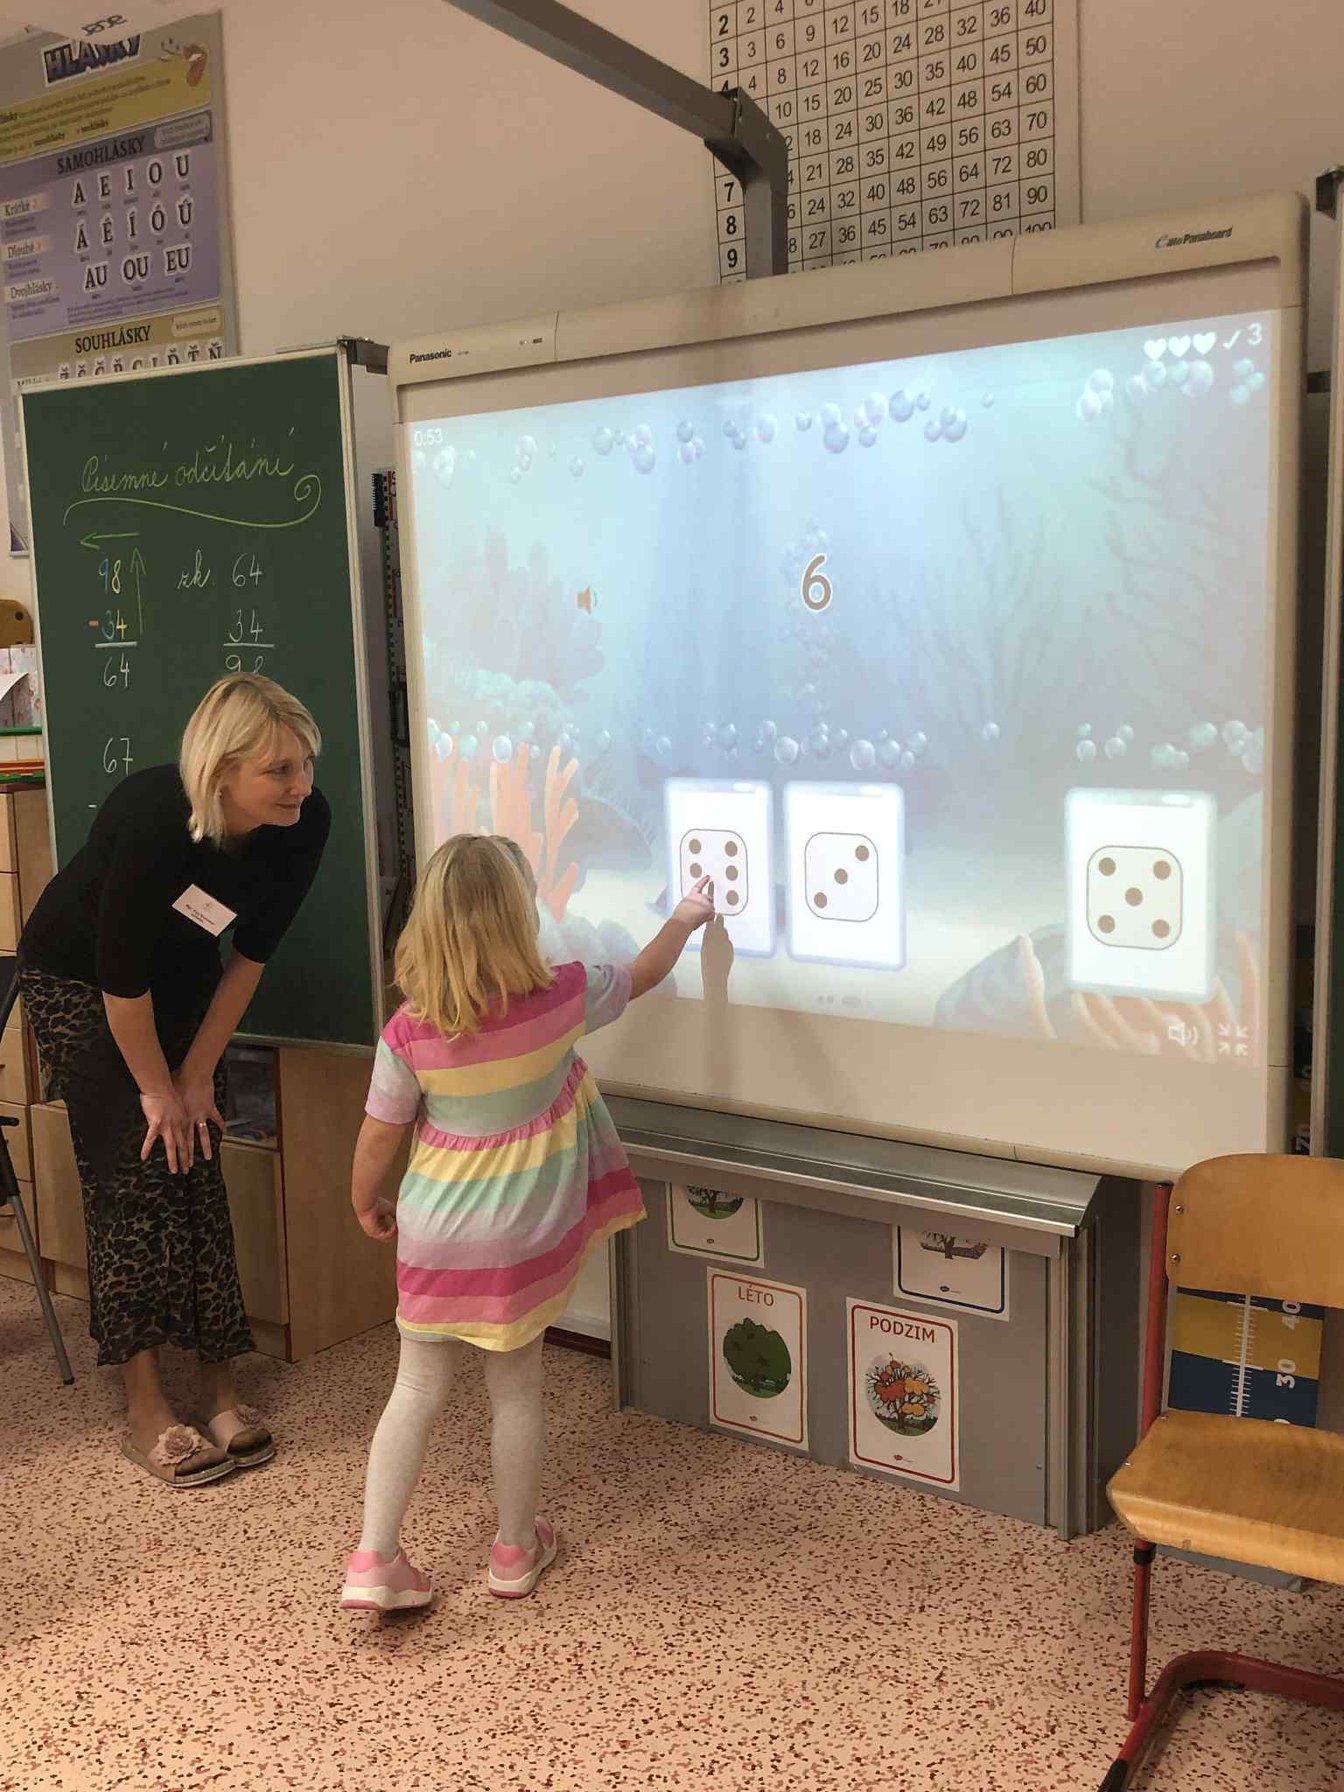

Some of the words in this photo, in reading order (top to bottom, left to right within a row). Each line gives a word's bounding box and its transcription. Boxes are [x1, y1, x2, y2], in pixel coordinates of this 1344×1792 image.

[719, 14, 728, 36] 2
[747, 7, 755, 24] 2
[775, 0, 784, 14] 4
[720, 48, 729, 67] 3
[748, 42, 756, 57] 3
[776, 34, 785, 49] 6
[806, 25, 815, 41] 9
[833, 16, 848, 34] 12
[862, 6, 879, 25] 15
[892, 0, 909, 16] 18
[749, 76, 756, 90] 4
[778, 68, 786, 84] 8
[803, 60, 819, 76] 12
[833, 51, 849, 69] 16
[864, 42, 881, 62] 20
[893, 34, 911, 54] 24
[925, 24, 944, 45] 28
[957, 16, 976, 36] 32
[991, 6, 1010, 27] 36
[1025, 0, 1046, 16] 40
[776, 102, 791, 119] 10
[804, 94, 820, 112] 15
[834, 86, 852, 105] 20
[865, 77, 882, 97] 25
[894, 70, 912, 89] 30
[926, 61, 944, 81] 35
[956, 54, 976, 72] 40
[990, 44, 1010, 63] 45
[1026, 36, 1046, 56] 50
[785, 136, 793, 151] 2
[805, 129, 821, 146] 18
[836, 121, 852, 140] 24
[866, 113, 883, 132] 30
[896, 106, 913, 125] 36
[926, 98, 945, 116] 42
[958, 91, 977, 109] 48
[992, 82, 1012, 102] 54
[1026, 74, 1046, 94] 60
[57, 136, 145, 175] SAMOHLÁSKY
[724, 182, 734, 202] 7
[807, 164, 822, 181] 21
[836, 156, 854, 175] 28
[867, 148, 884, 167] 35
[896, 142, 914, 159] 42
[927, 134, 946, 152] 49
[959, 127, 978, 146] 56
[992, 119, 1011, 138] 63
[1027, 112, 1047, 131] 70
[74, 182, 86, 203] A
[100, 175, 111, 197] E
[127, 169, 134, 190] I
[149, 162, 161, 184] O
[176, 155, 189, 177] U
[726, 216, 736, 234] 8
[808, 197, 825, 215] 24
[838, 191, 854, 209] 32
[867, 184, 885, 201] 40
[896, 177, 915, 194] 48
[928, 170, 947, 188] 56
[960, 163, 979, 182] 64
[992, 156, 1012, 174] 72
[1027, 148, 1047, 168] 80
[77, 223, 88, 249] Á
[103, 217, 114, 243] É
[129, 211, 136, 237] Í
[152, 205, 165, 231] Ó
[727, 248, 737, 268] 9
[809, 231, 826, 249] 27
[839, 225, 855, 243] 36
[868, 218, 886, 236] 45
[898, 212, 916, 230] 54
[929, 206, 948, 224] 63
[960, 200, 980, 218] 72
[993, 192, 1010, 211] 81
[1028, 186, 1047, 204] 90
[85, 265, 107, 289] AU
[123, 256, 149, 280] OU
[166, 247, 190, 272] EU
[75, 326, 151, 353] SOUHLÁSKY
[1247, 322, 1262, 346] 3
[409, 348, 452, 363] Panasonic
[414, 428, 443, 447] 0:53
[99, 558, 122, 594] 98
[232, 553, 263, 587] 64
[801, 553, 833, 612] 6
[228, 608, 264, 643] 34
[103, 652, 130, 688] 64
[103, 738, 134, 775] 67
[737, 1285, 775, 1307] LÉTO
[869, 1316, 936, 1344] PODZIM
[1281, 1300, 1301, 1330] 40
[1275, 1358, 1297, 1389] 30
